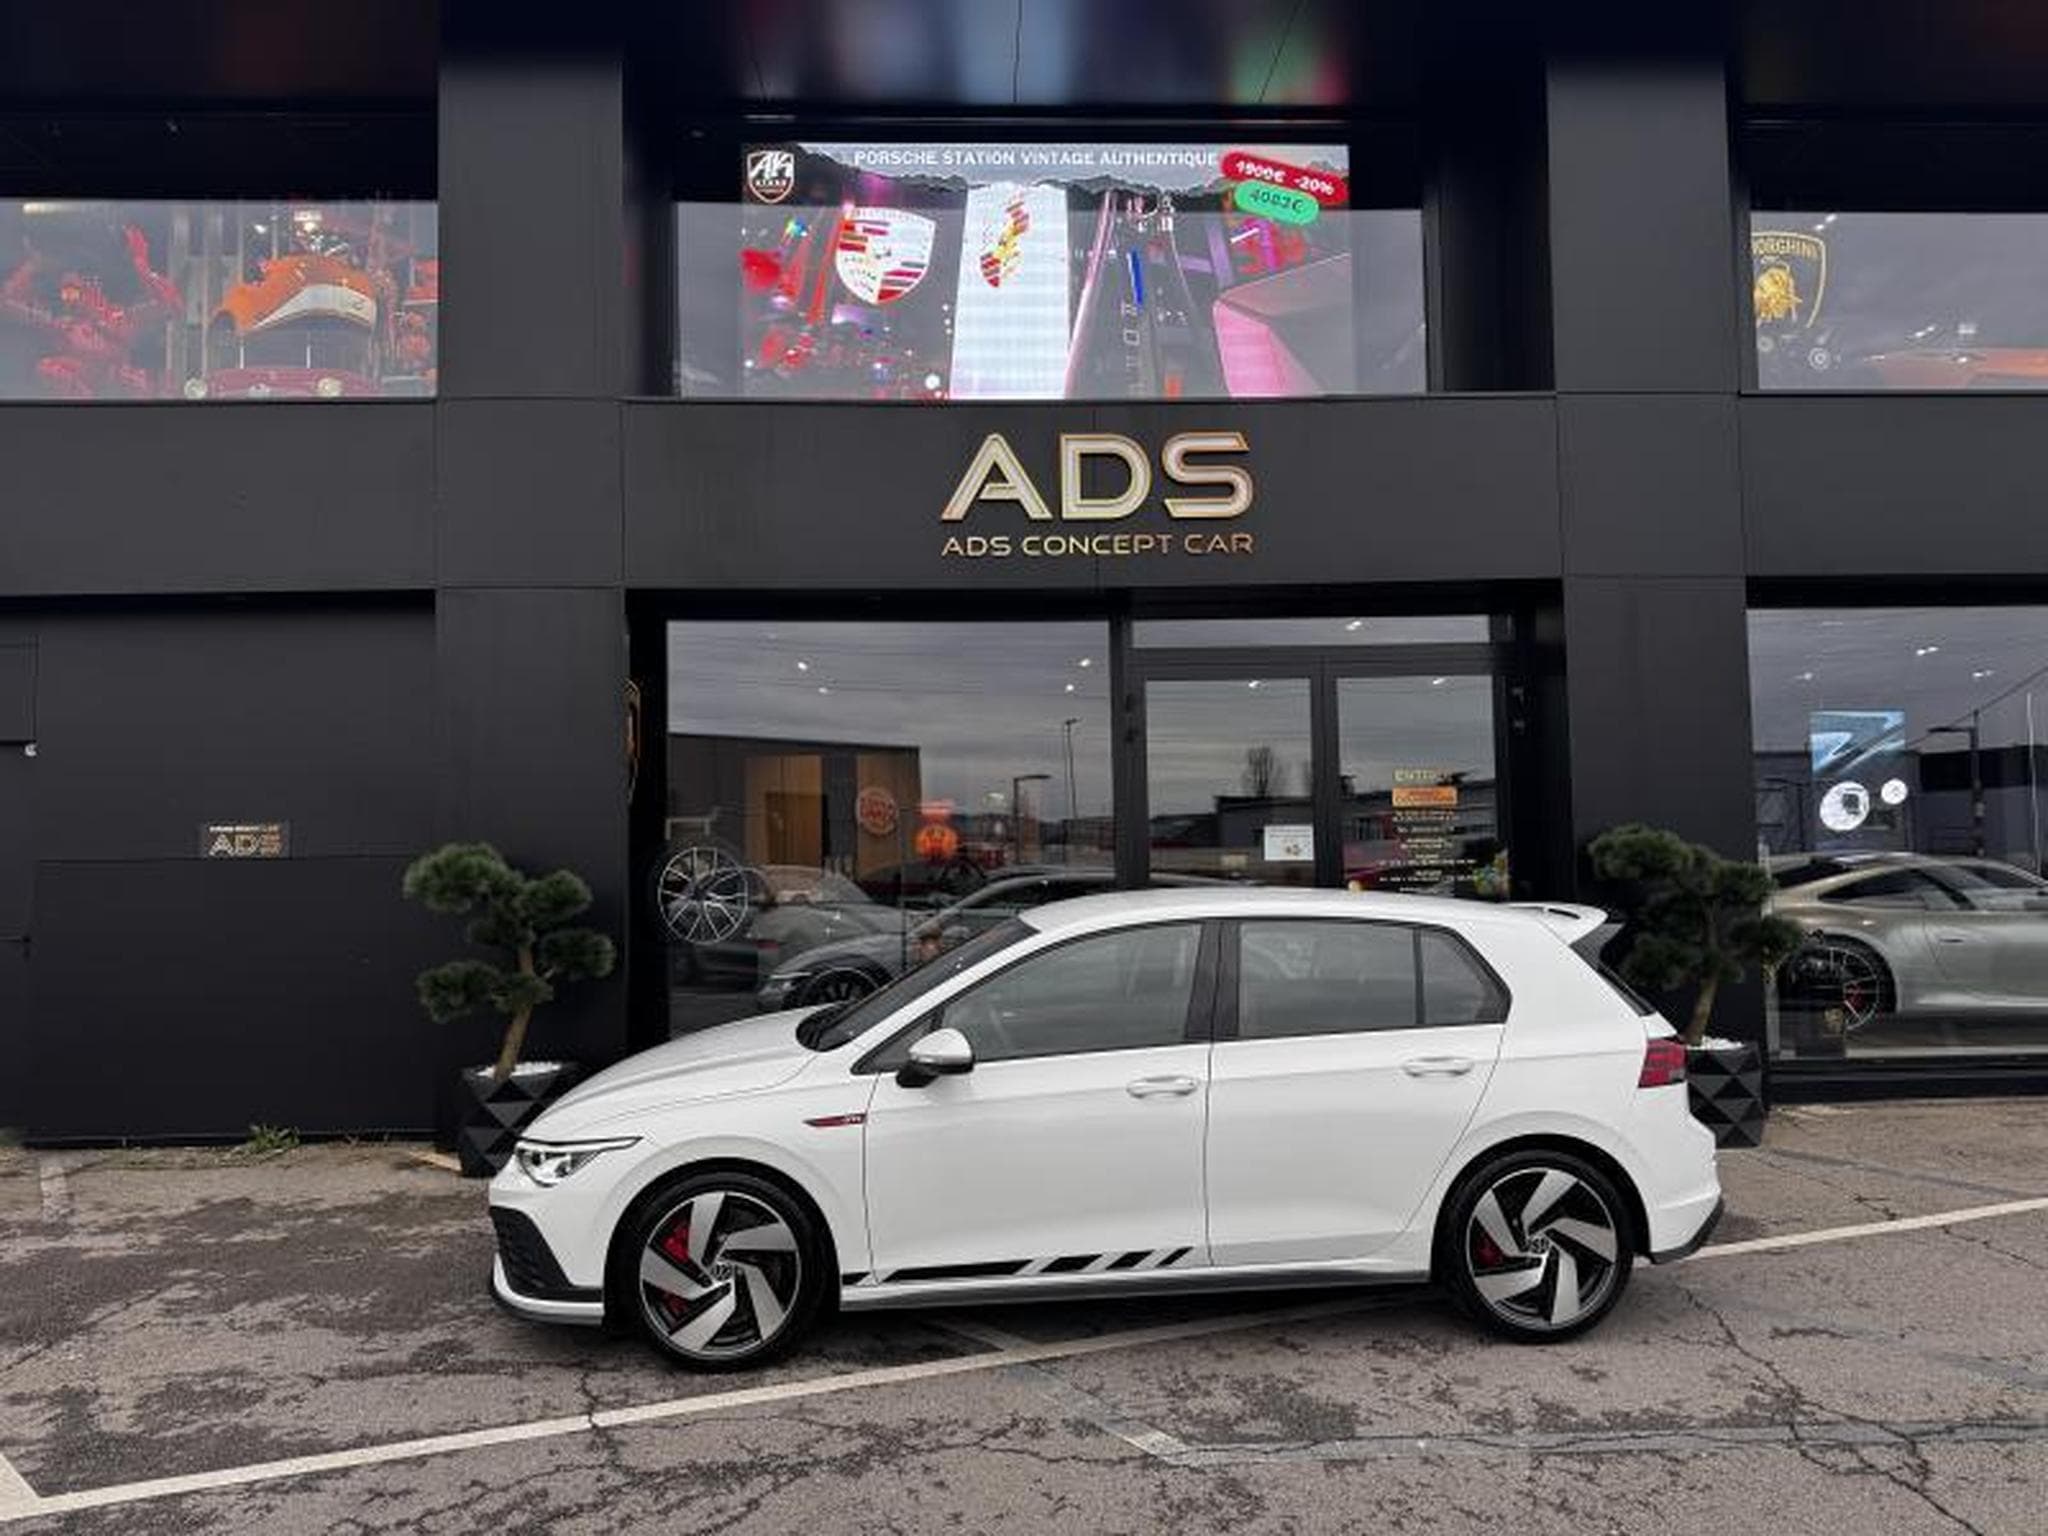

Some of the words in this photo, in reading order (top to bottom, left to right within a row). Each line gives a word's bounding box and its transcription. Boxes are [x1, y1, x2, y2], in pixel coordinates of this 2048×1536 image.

[855, 151, 938, 165] PORSCHE
[943, 151, 1015, 165] STATION
[1020, 151, 1095, 165] VINTAGE
[1100, 151, 1216, 166] AUTHENTIQUE
[1293, 176, 1335, 196] -20%
[941, 432, 1253, 520] ADS
[941, 536, 1012, 557] ADS
[1022, 534, 1173, 556] CONCEPT
[1184, 533, 1254, 554] CAR
